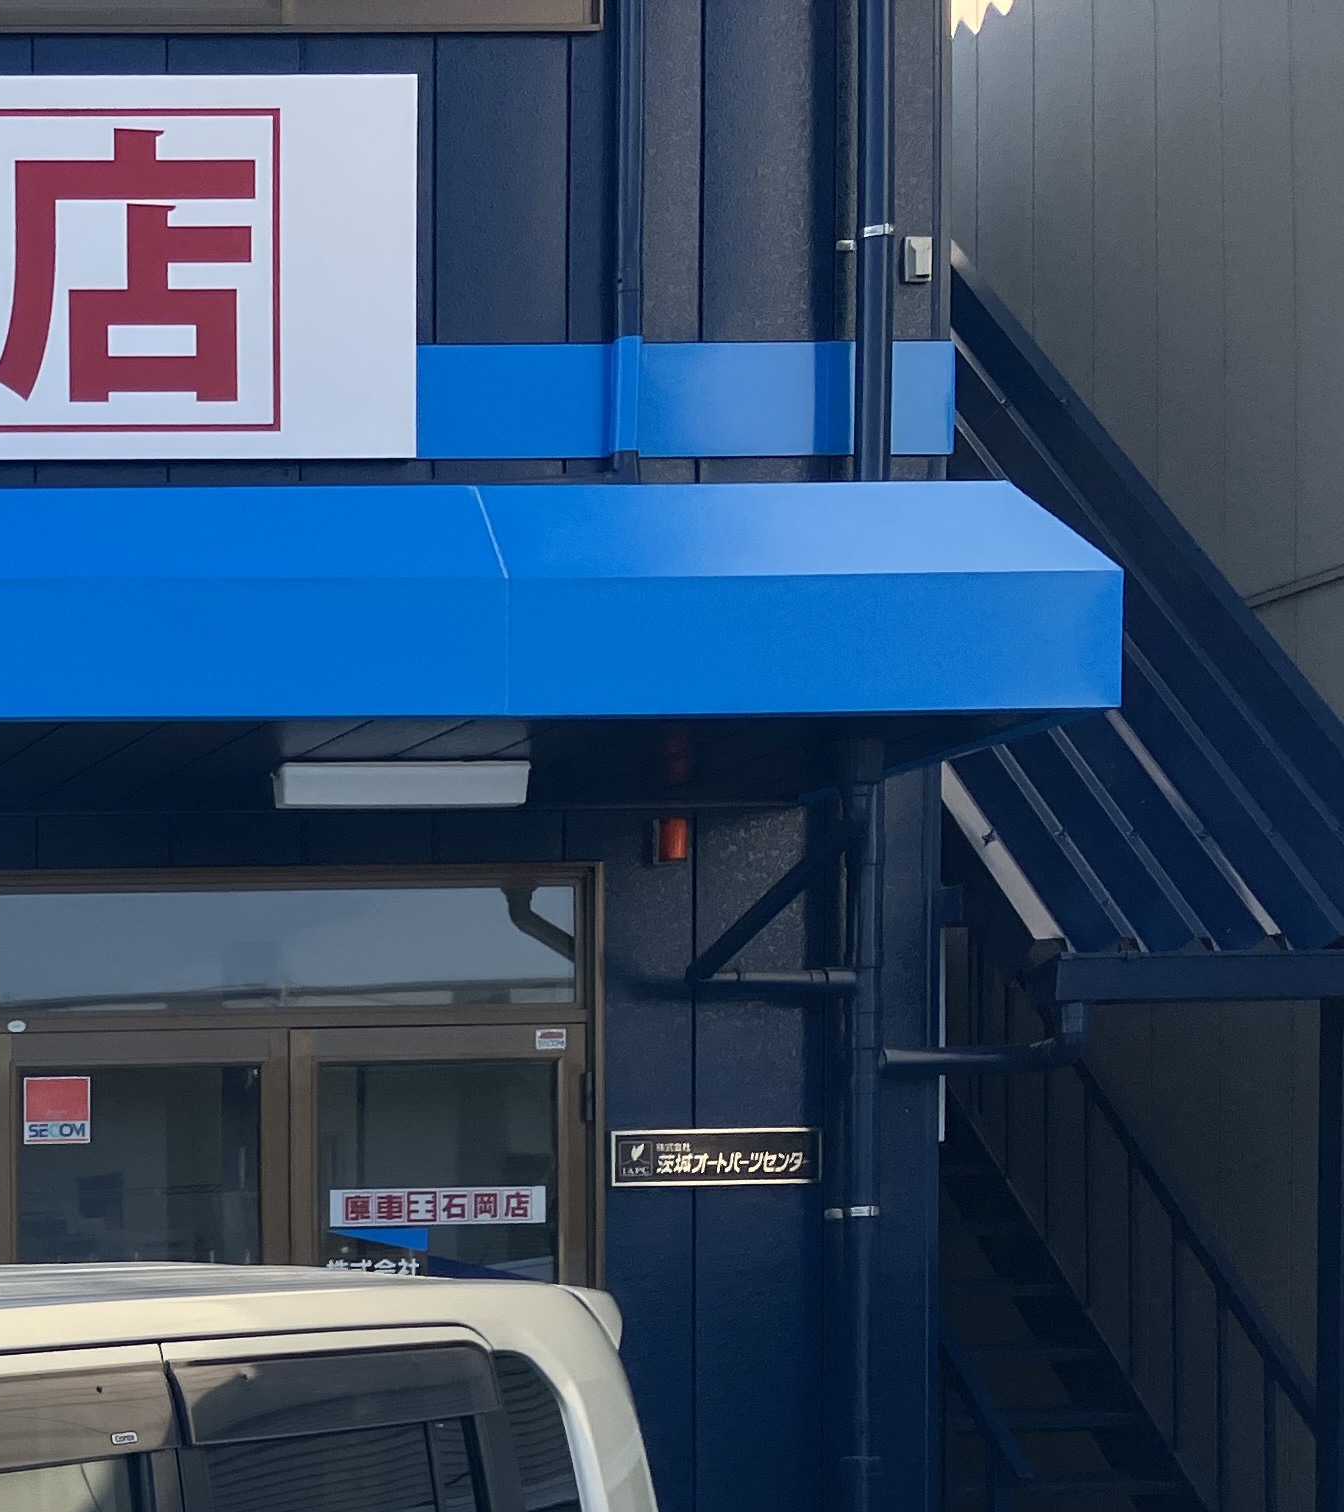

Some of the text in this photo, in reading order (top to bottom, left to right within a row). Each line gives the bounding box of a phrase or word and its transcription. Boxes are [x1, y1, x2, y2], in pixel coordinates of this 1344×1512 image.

[28, 1123, 86, 1138] SECOM
[344, 1190, 532, 1222] 廃車王石岡店
